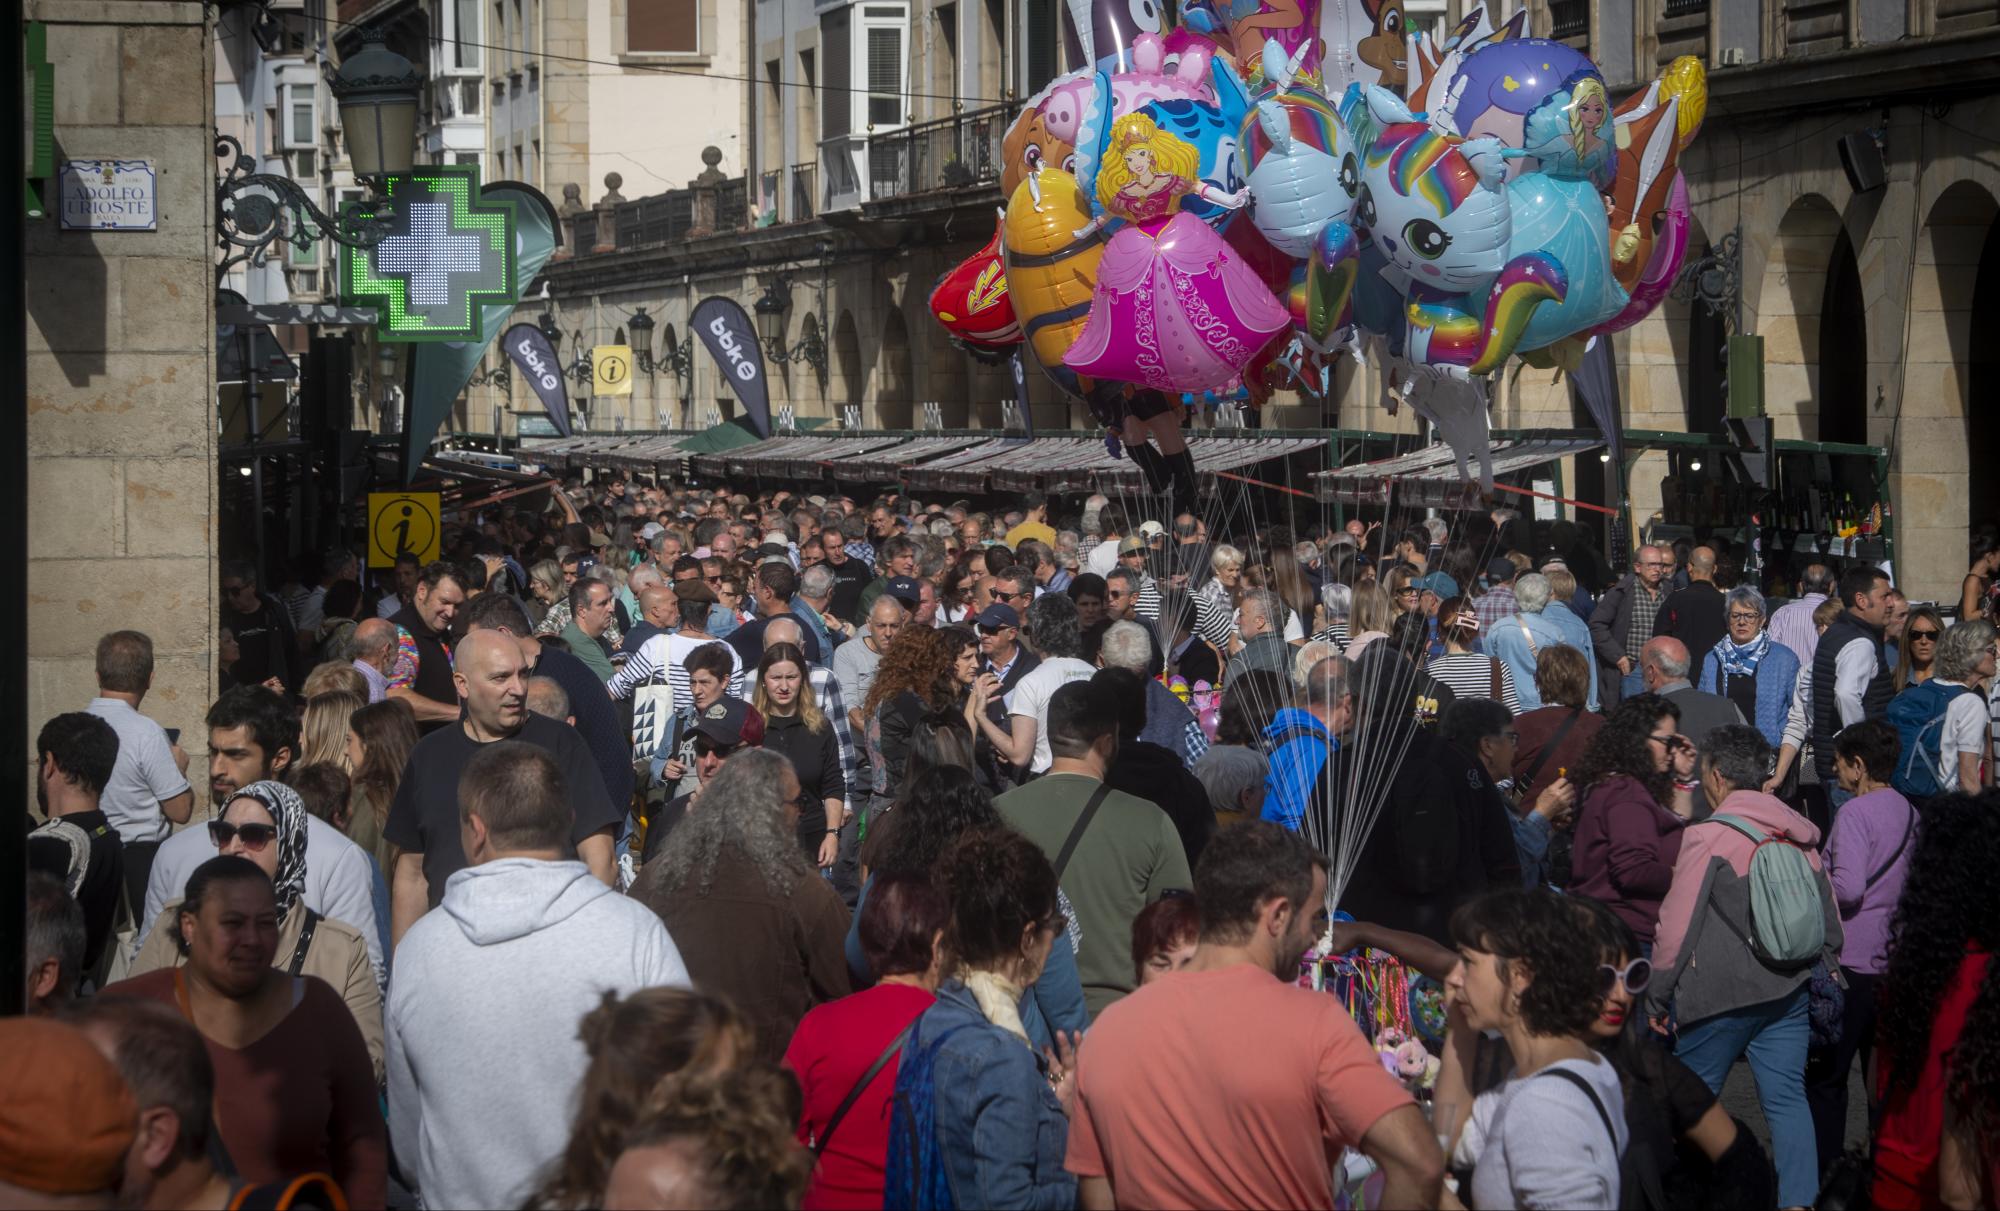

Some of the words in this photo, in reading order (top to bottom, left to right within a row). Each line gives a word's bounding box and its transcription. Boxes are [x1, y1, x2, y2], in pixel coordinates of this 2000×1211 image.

[73, 187, 145, 200] ADOLFO
[67, 201, 149, 214] URIOSTE
[710, 316, 744, 365] bbk
[518, 339, 548, 378] bbk
